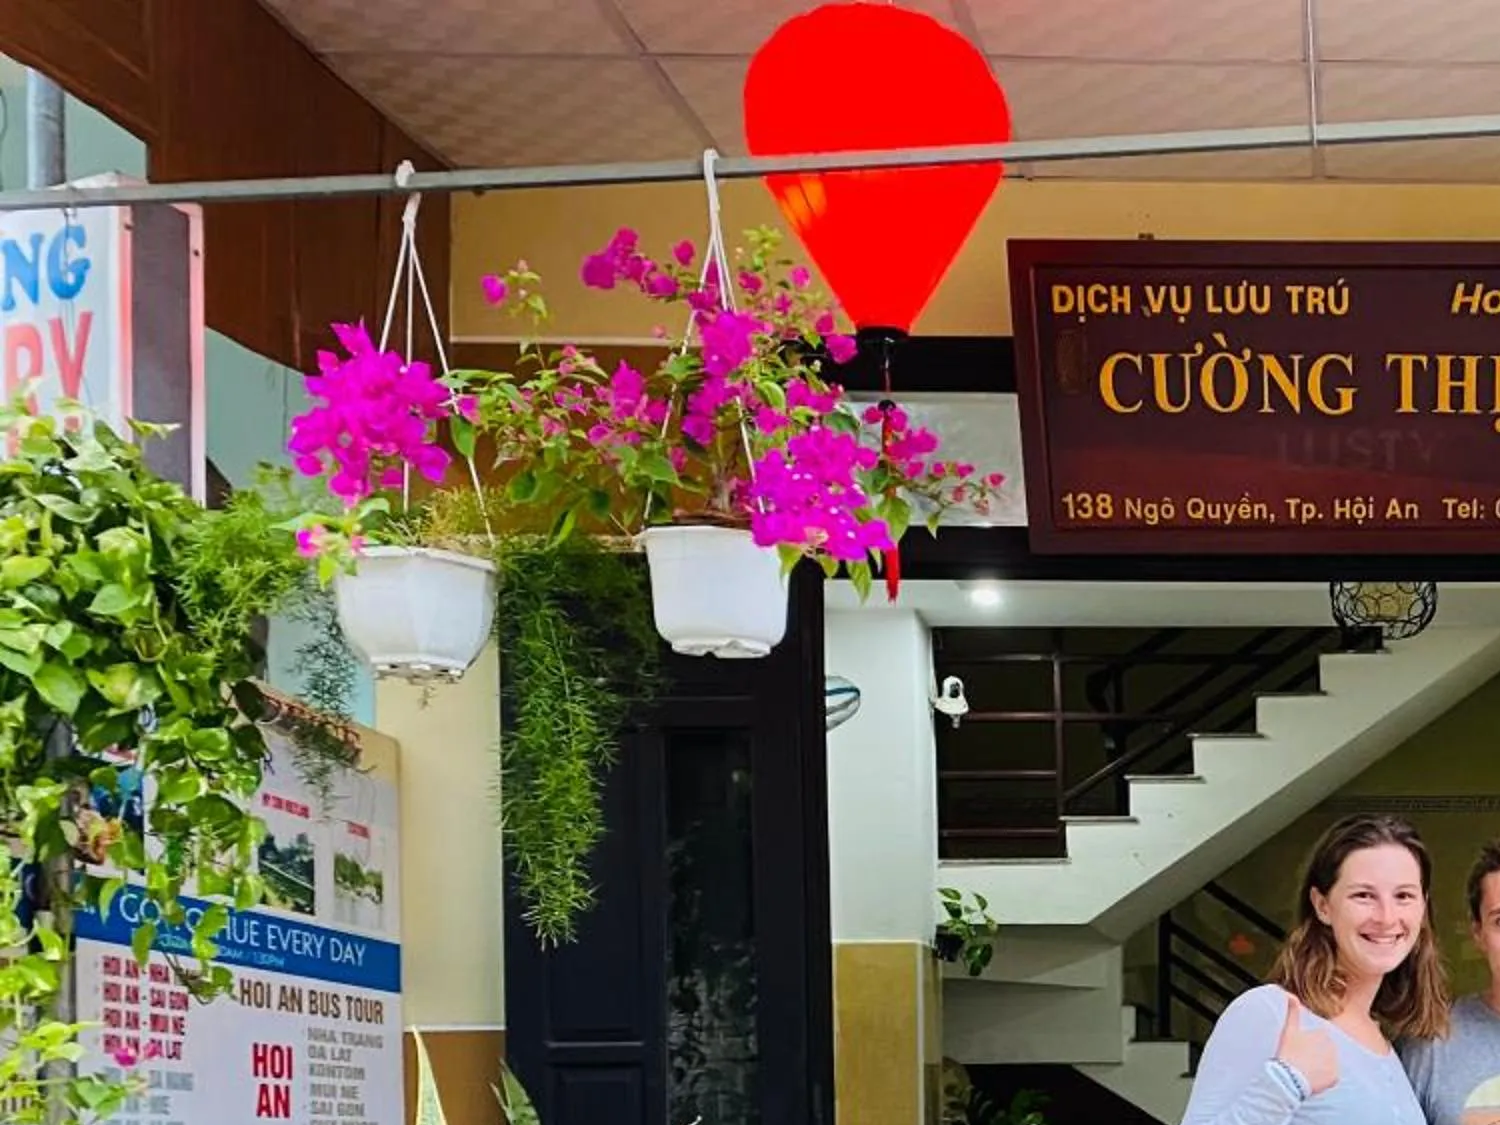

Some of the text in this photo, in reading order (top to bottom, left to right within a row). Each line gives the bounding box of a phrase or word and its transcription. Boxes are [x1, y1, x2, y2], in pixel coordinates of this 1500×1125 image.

[1052, 278, 1349, 323] DỊCH VỤ LƯU TRÚ
[1099, 332, 1359, 416] CƯỜNG
[1062, 492, 1419, 525] 138 Ngô Quyền, Tp. Hội An
[1442, 497, 1485, 520] Tel:
[266, 924, 325, 959] EVERY
[330, 937, 367, 967] DAY
[240, 978, 384, 1025] HOI AN BUS TOUR
[252, 1043, 293, 1081] HOI
[256, 1083, 291, 1119] AN
